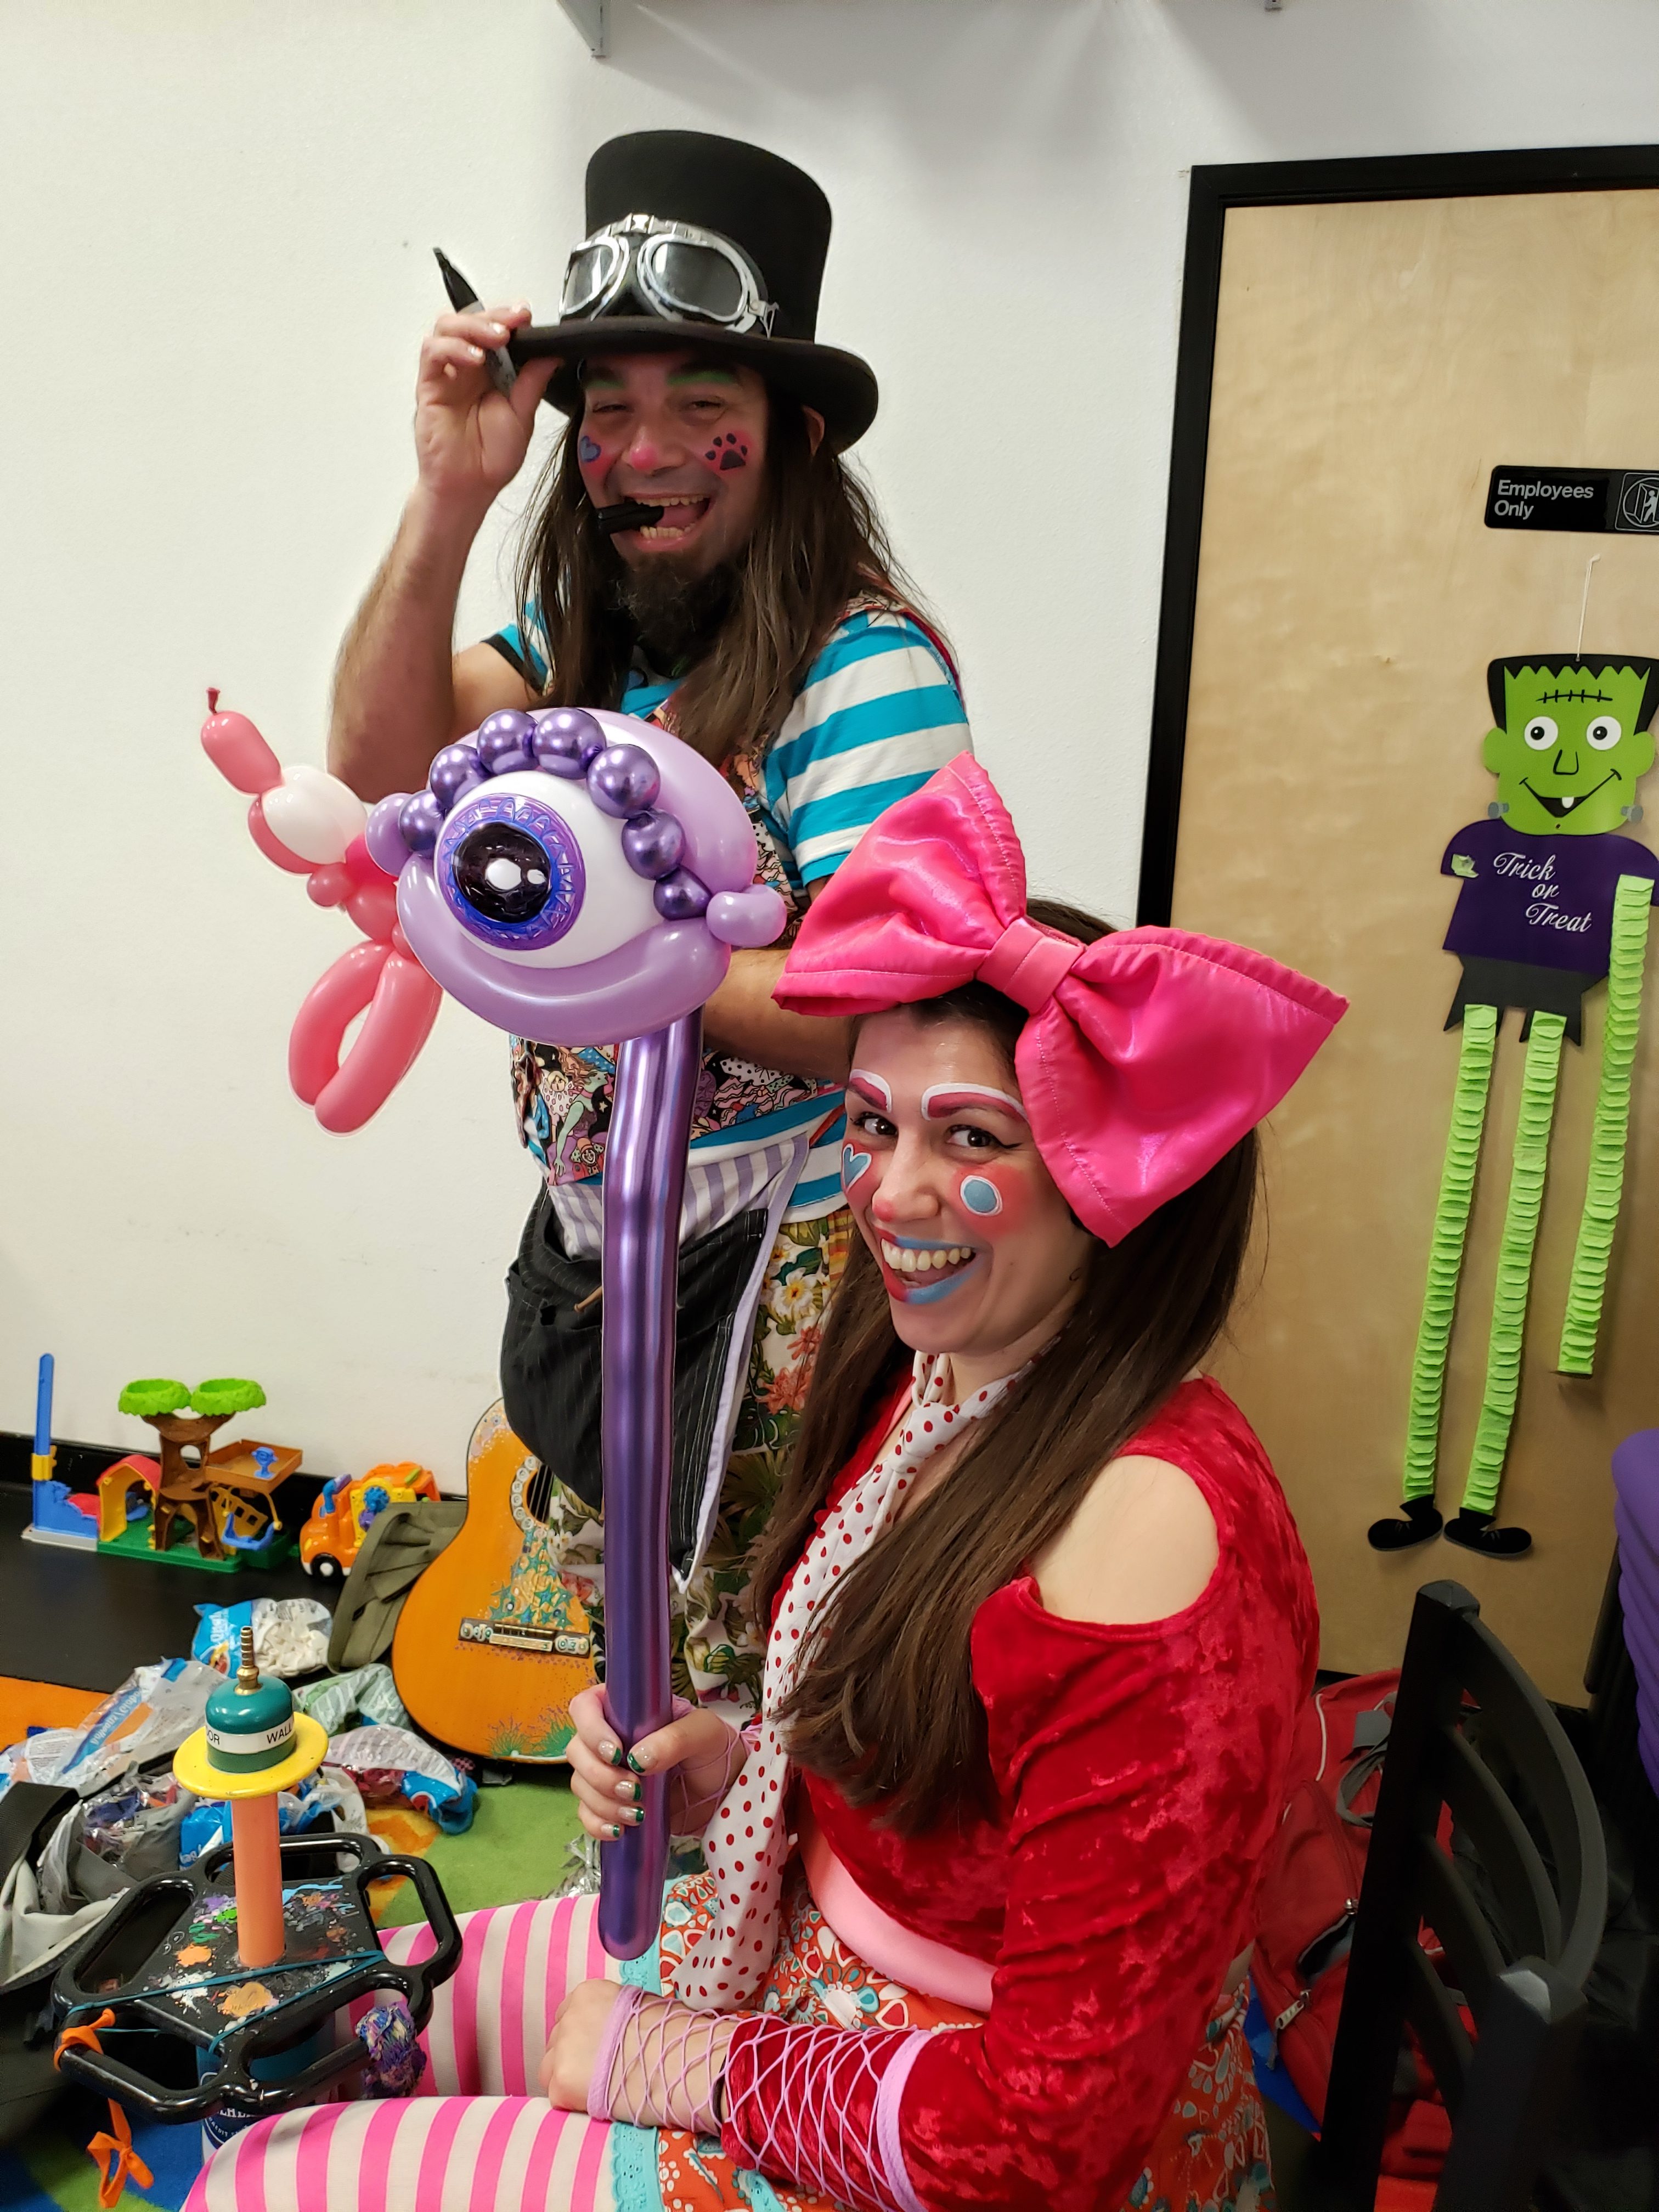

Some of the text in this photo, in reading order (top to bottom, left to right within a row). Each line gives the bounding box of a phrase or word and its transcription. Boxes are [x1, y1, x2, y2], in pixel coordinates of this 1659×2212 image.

[1497, 479, 1594, 500] Employees
[1494, 500, 1534, 520] Only
[1493, 852, 1556, 881] Trick
[1532, 883, 1559, 899] or
[1526, 902, 1592, 933] Treat
[207, 1730, 220, 1745] OR
